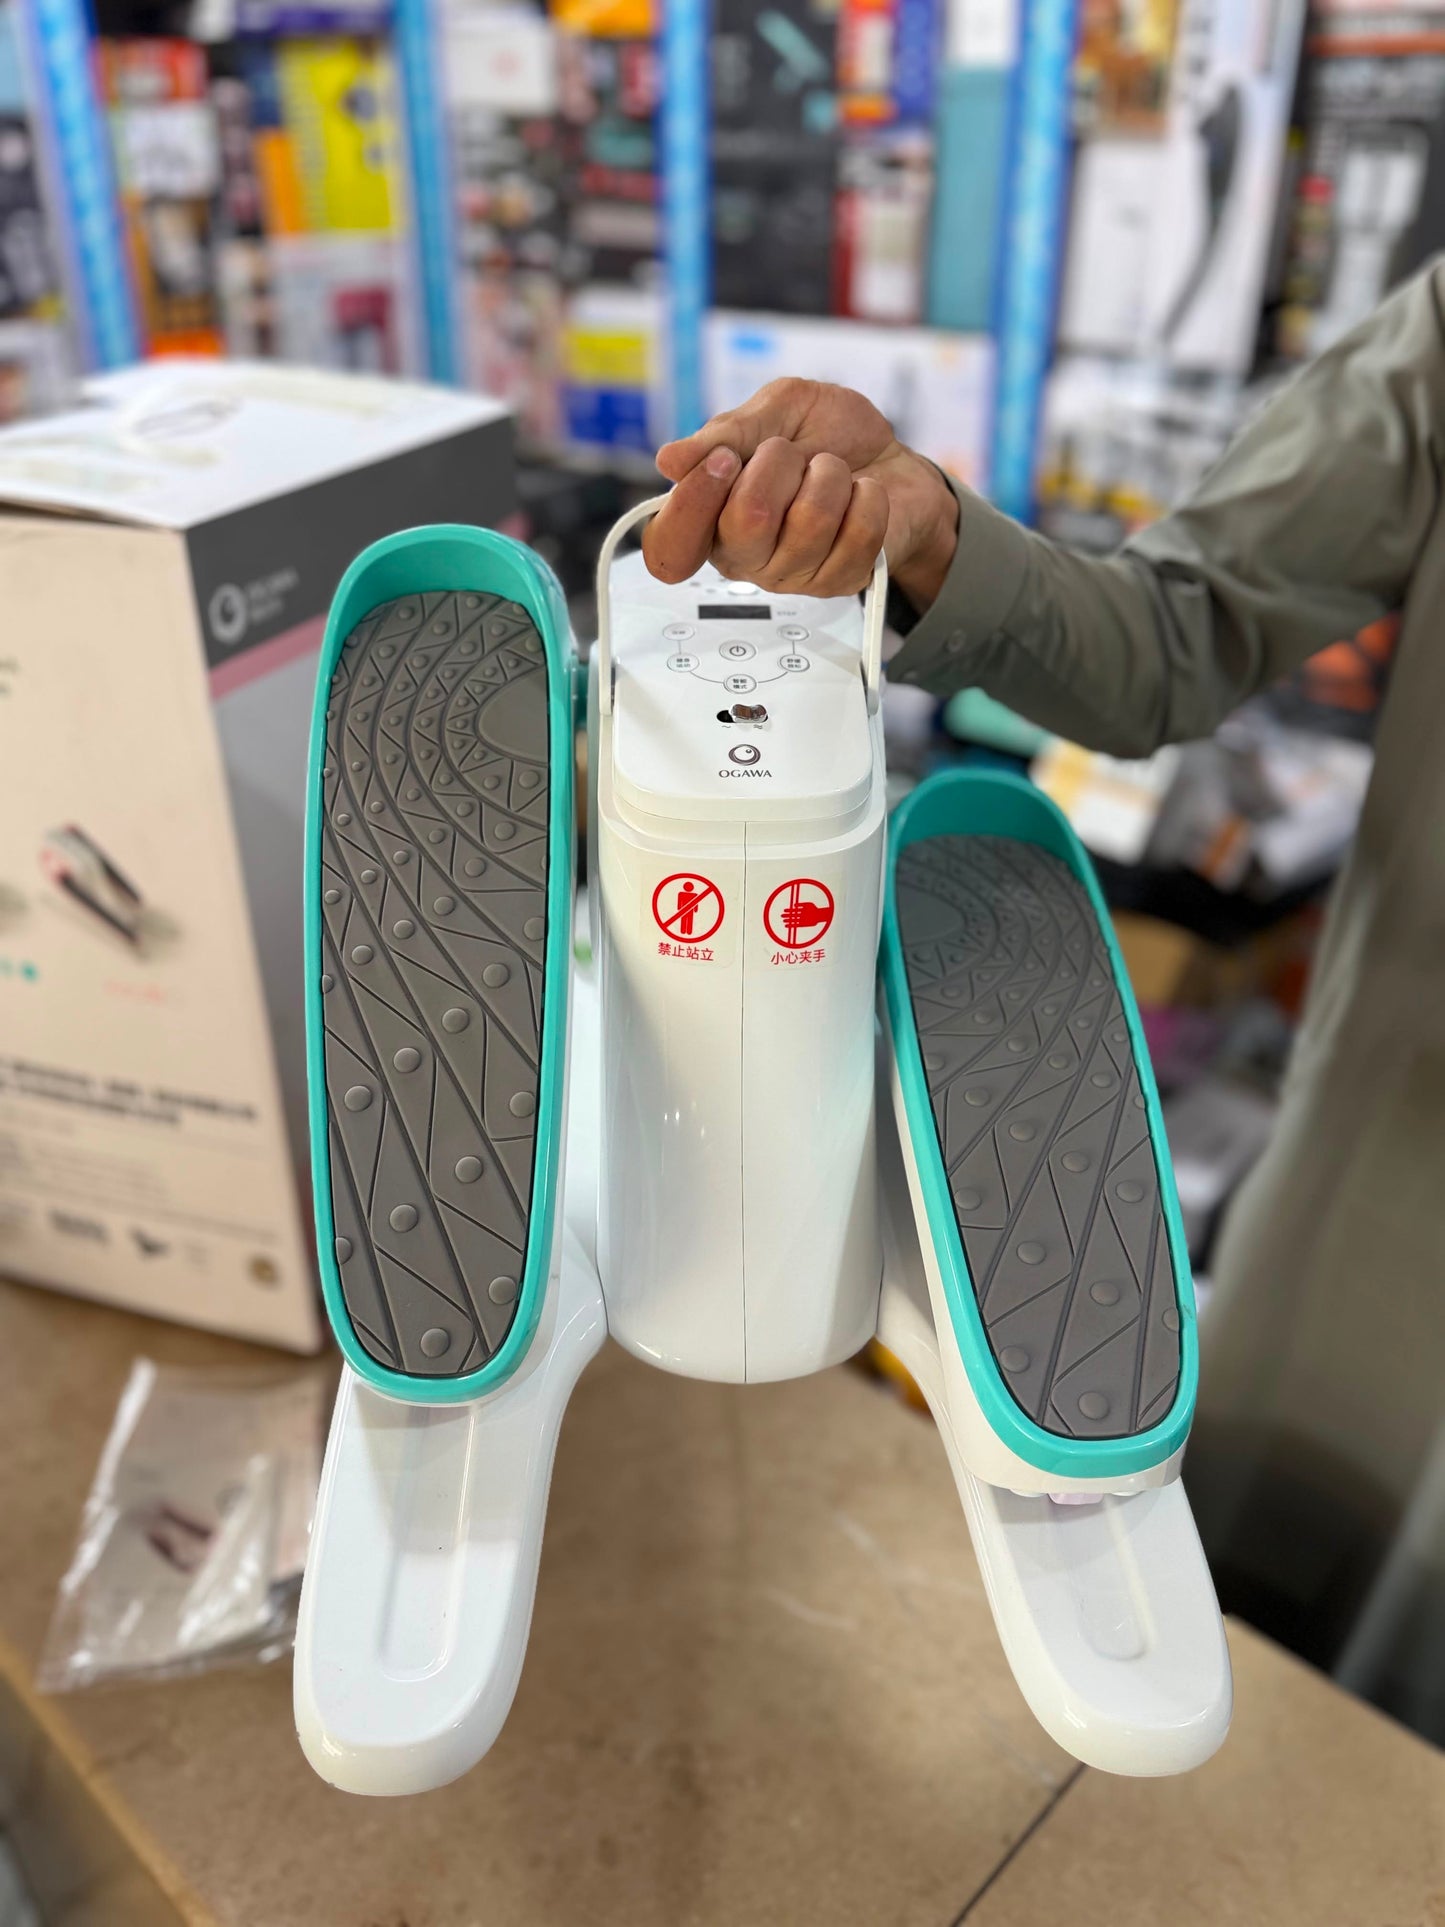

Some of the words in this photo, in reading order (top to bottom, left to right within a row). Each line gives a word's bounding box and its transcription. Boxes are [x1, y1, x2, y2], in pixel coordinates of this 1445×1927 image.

[718, 769, 773, 778] OGAWA
[657, 942, 714, 962] 禁止站立
[770, 948, 826, 966] 小心夹手
